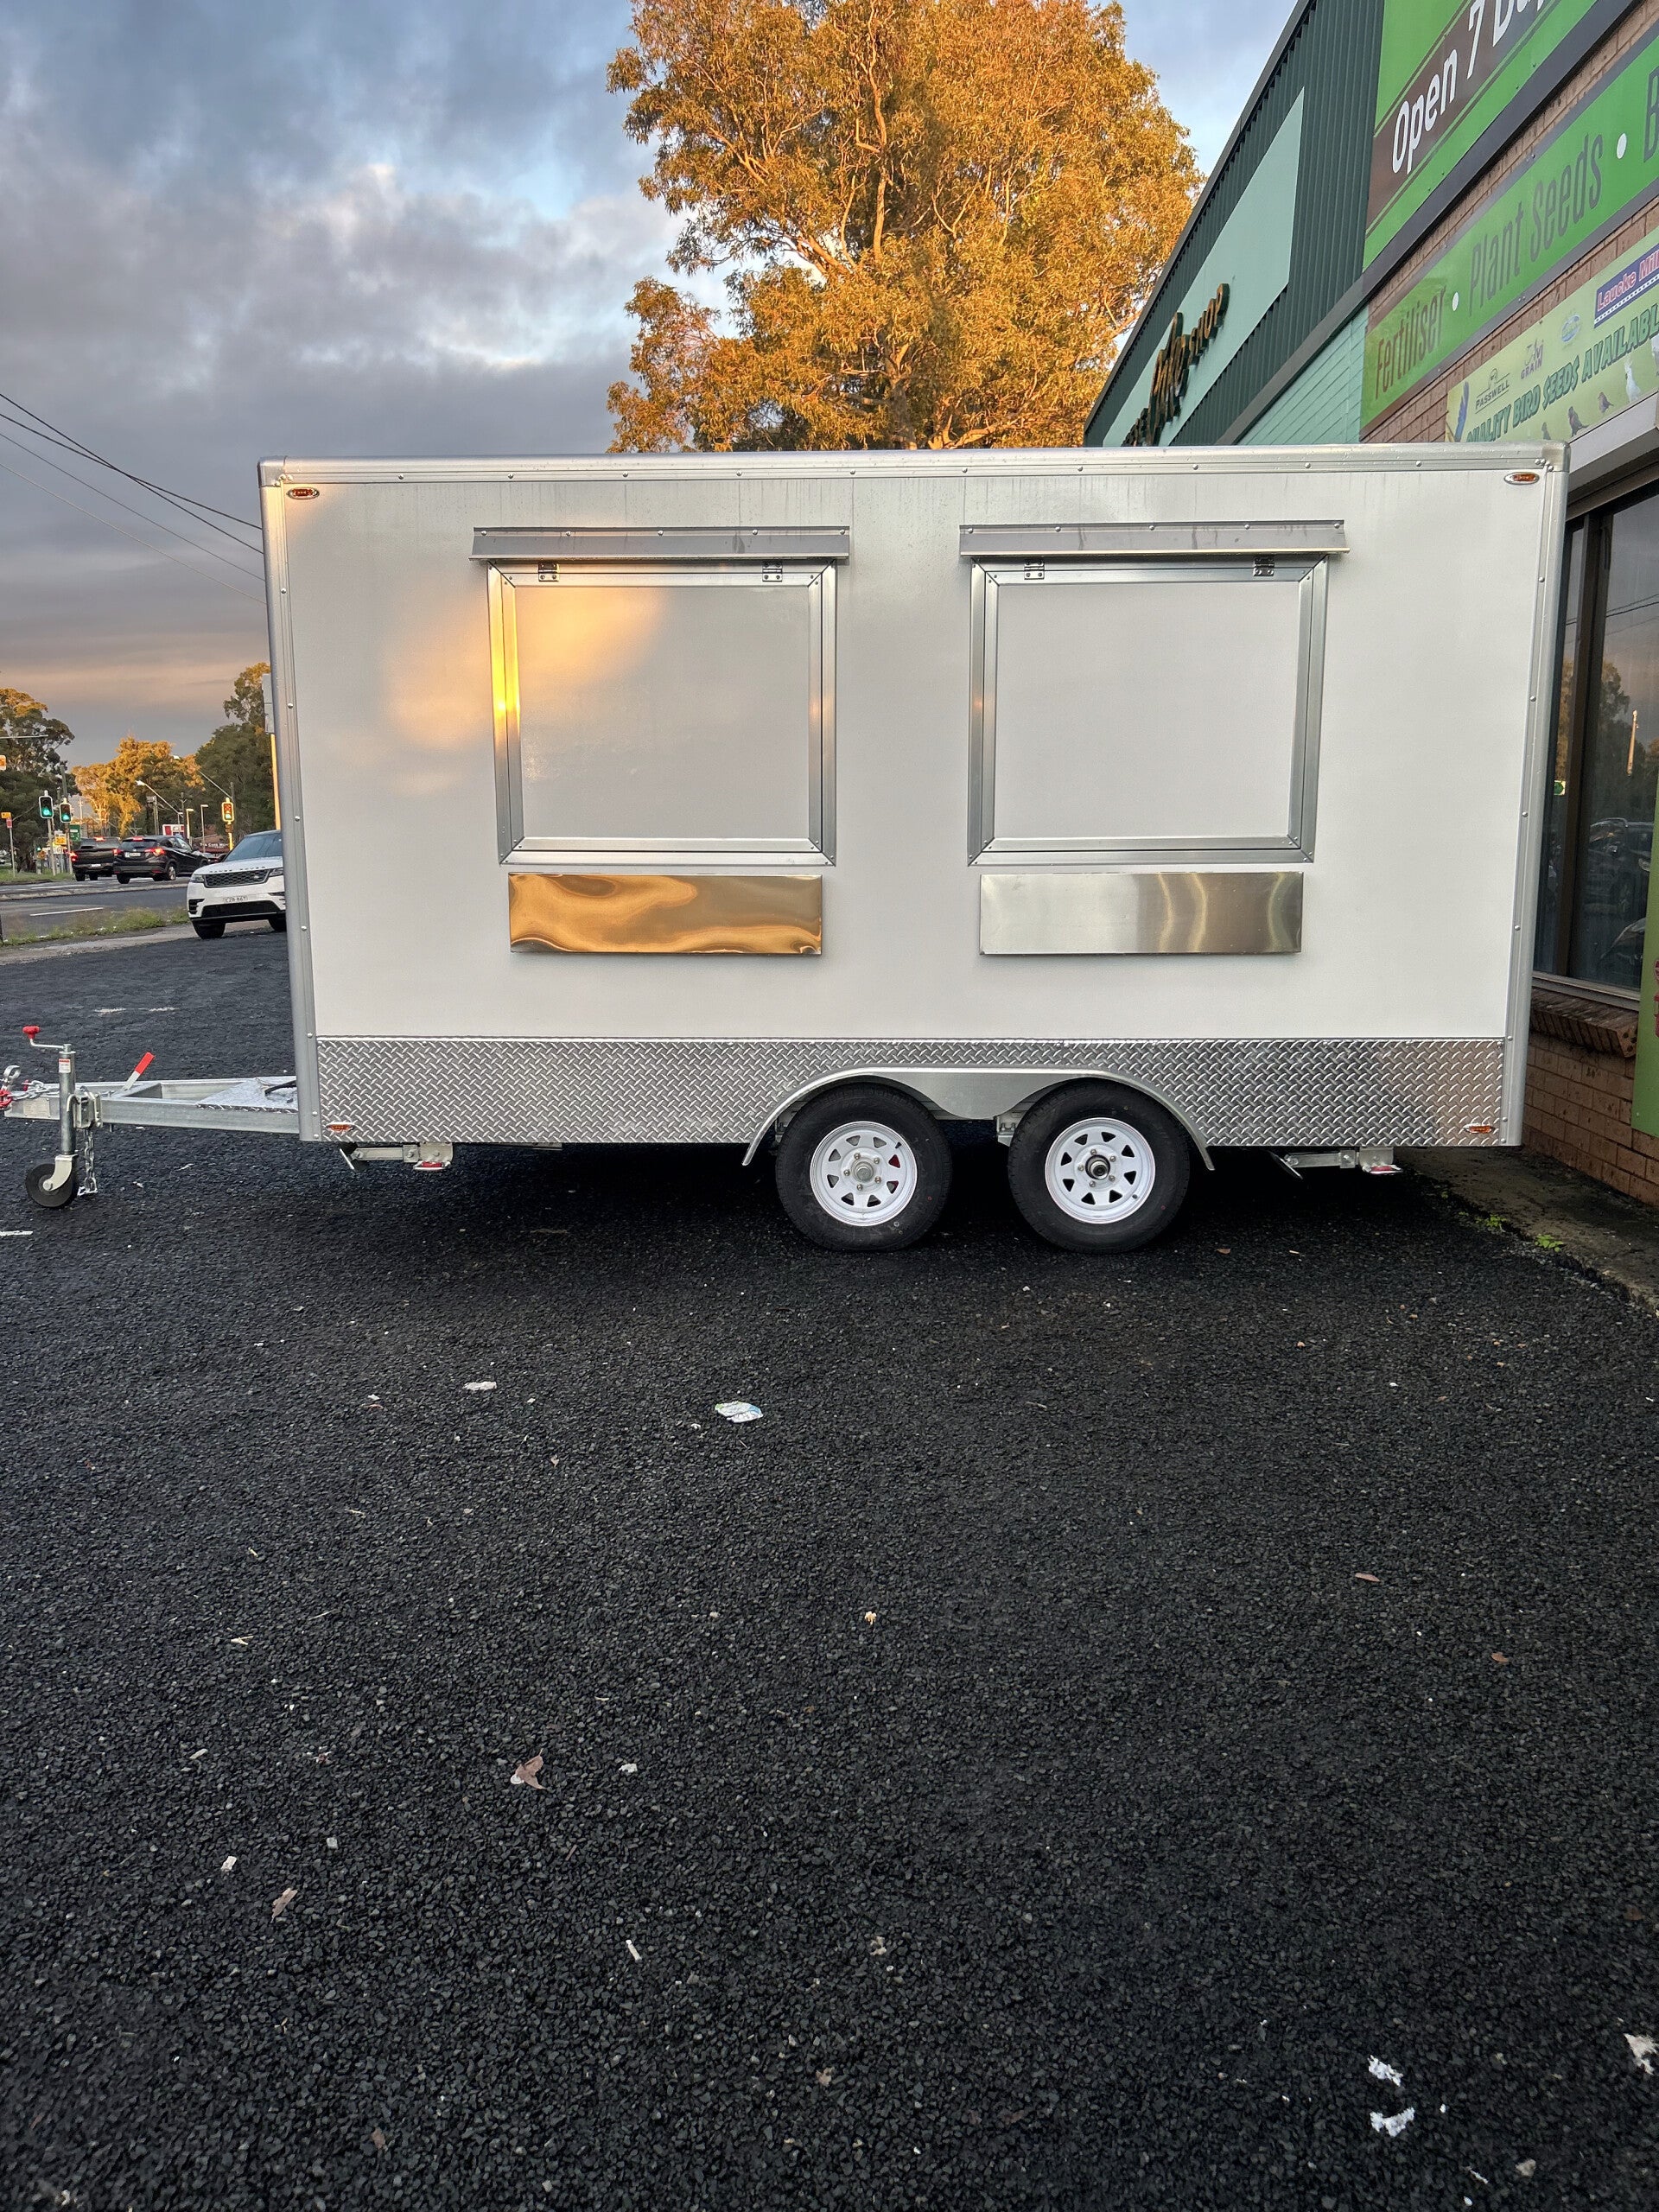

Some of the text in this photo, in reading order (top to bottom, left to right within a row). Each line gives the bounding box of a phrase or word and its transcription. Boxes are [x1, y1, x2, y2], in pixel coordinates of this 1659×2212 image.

[1392, 0, 1486, 175] Open 7
[1376, 133, 1603, 400] Fertiliser Plant Seeds
[1597, 271, 1637, 312] Laucke
[1476, 379, 1510, 410] PASSWELL
[1512, 384, 1541, 429] BIRD
[1542, 354, 1580, 410] SEEDS
[1521, 359, 1543, 379] GRAIN
